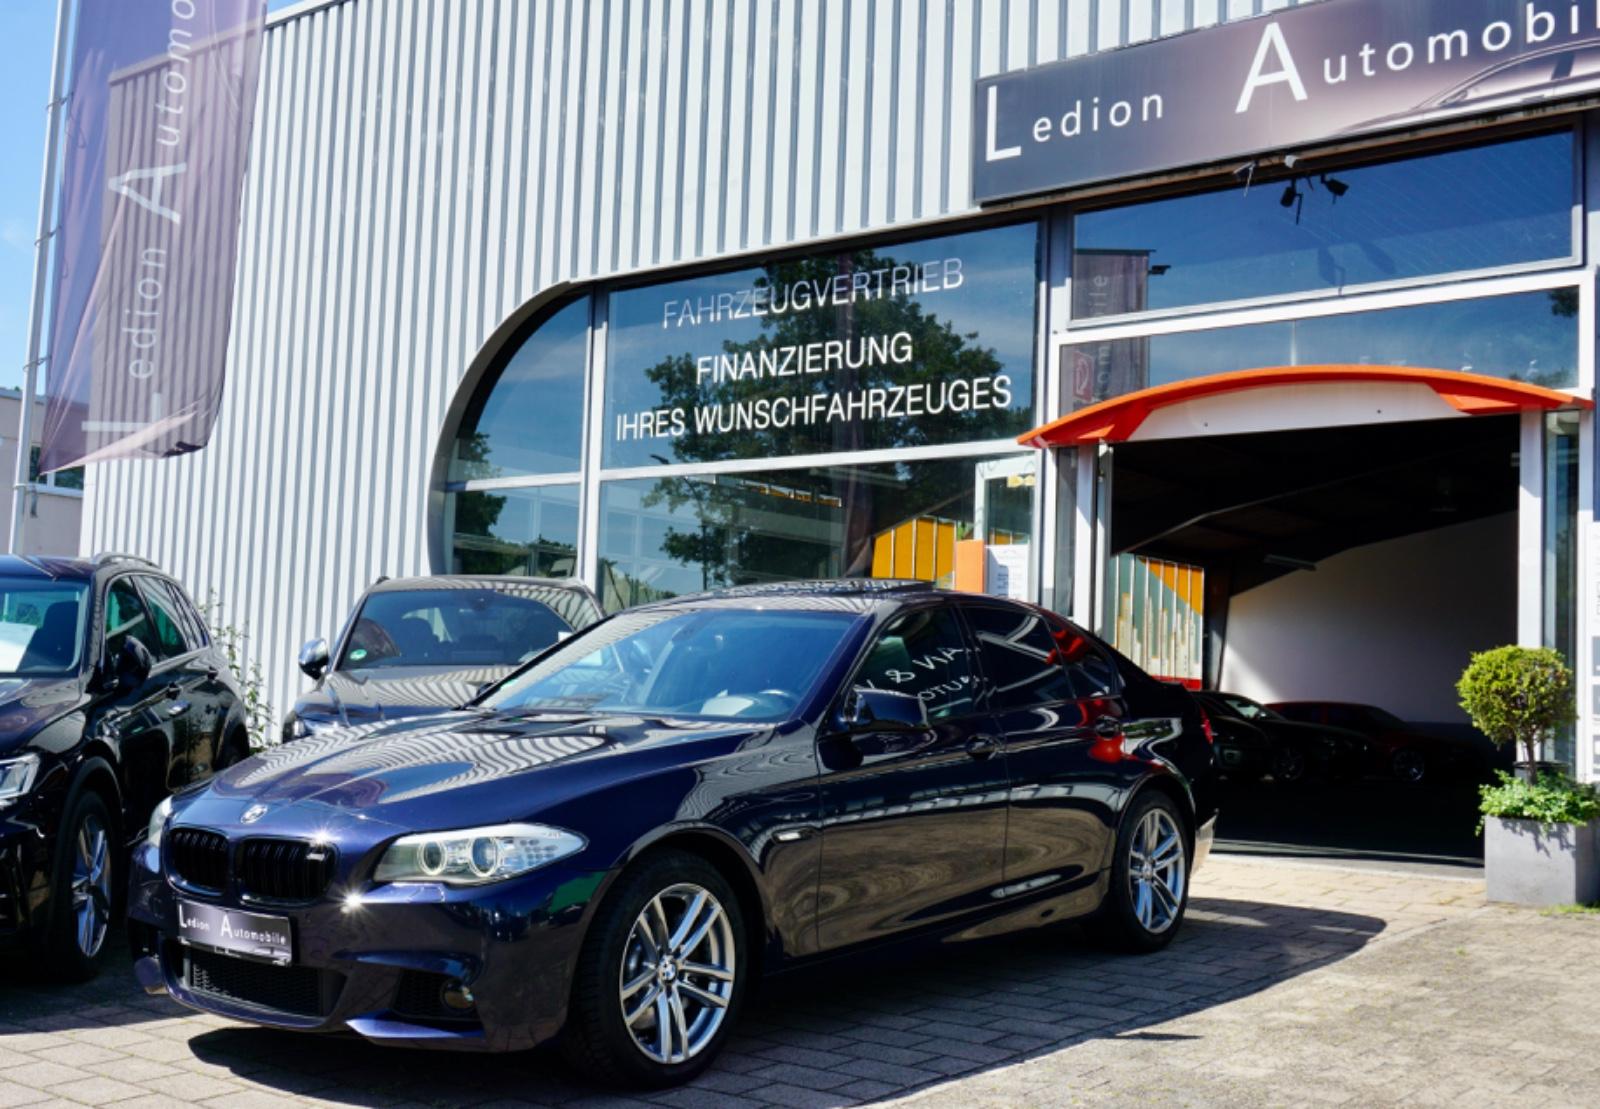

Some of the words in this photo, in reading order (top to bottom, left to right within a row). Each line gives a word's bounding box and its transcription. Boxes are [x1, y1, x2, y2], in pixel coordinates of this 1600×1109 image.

[985, 84, 1164, 163] Ledion
[662, 257, 965, 330] FAHRZEUGVERTRIEB
[696, 331, 914, 386] FINANZIERUNG
[616, 407, 686, 442] IHRES
[693, 374, 1013, 435] WUNSCHFAHRZEUGES
[221, 913, 287, 945] Automobile
